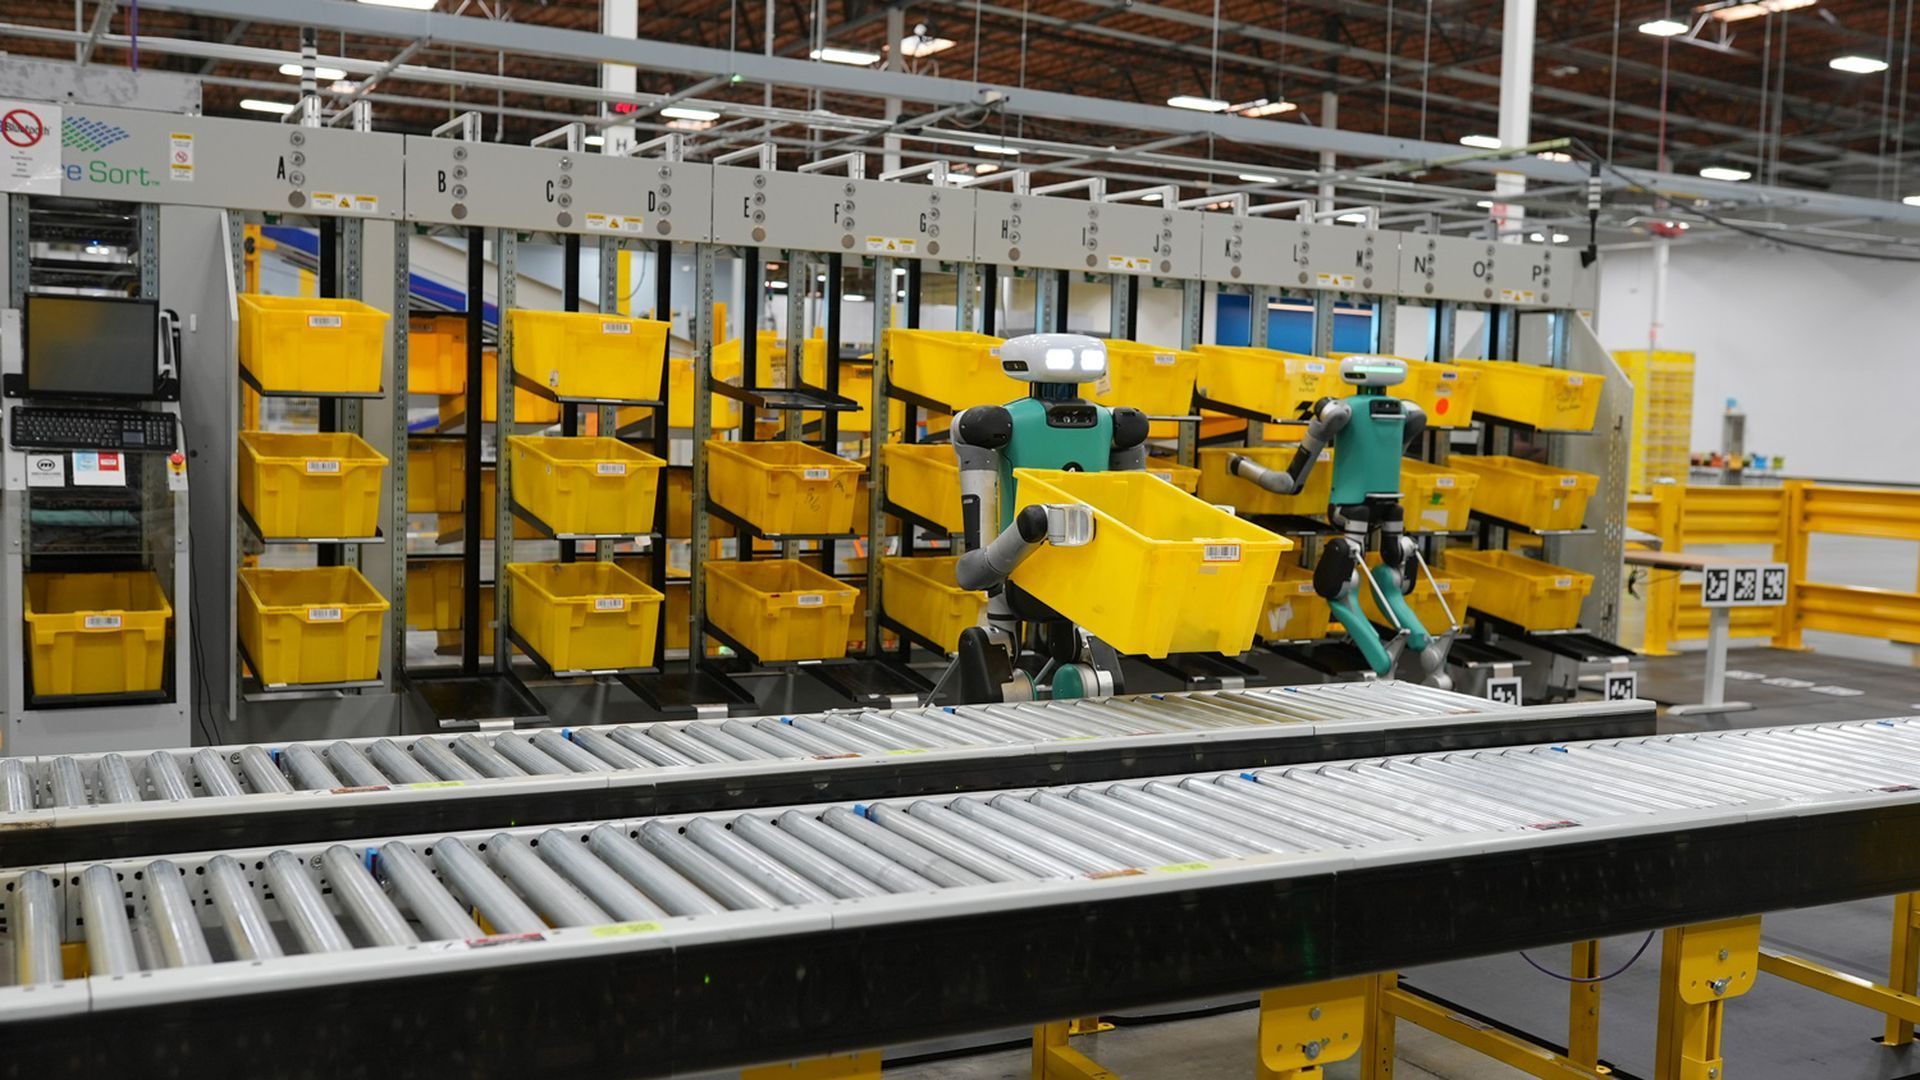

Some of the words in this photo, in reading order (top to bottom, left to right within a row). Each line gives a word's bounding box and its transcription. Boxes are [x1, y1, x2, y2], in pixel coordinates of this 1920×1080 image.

[5, 120, 50, 136] Bluetooh
[62, 164, 82, 181] e
[277, 156, 286, 180] A
[438, 170, 447, 193] B
[546, 180, 554, 202] C
[648, 191, 656, 212] D
[744, 197, 750, 218] E
[834, 203, 840, 224] F
[920, 213, 927, 233] G
[1001, 219, 1009, 239] H
[1082, 227, 1086, 247] I
[1153, 234, 1160, 253] J
[1225, 239, 1232, 257] K
[1293, 244, 1299, 263] L
[1414, 256, 1426, 273] N
[1473, 261, 1486, 278] O
[1532, 265, 1542, 281] P
